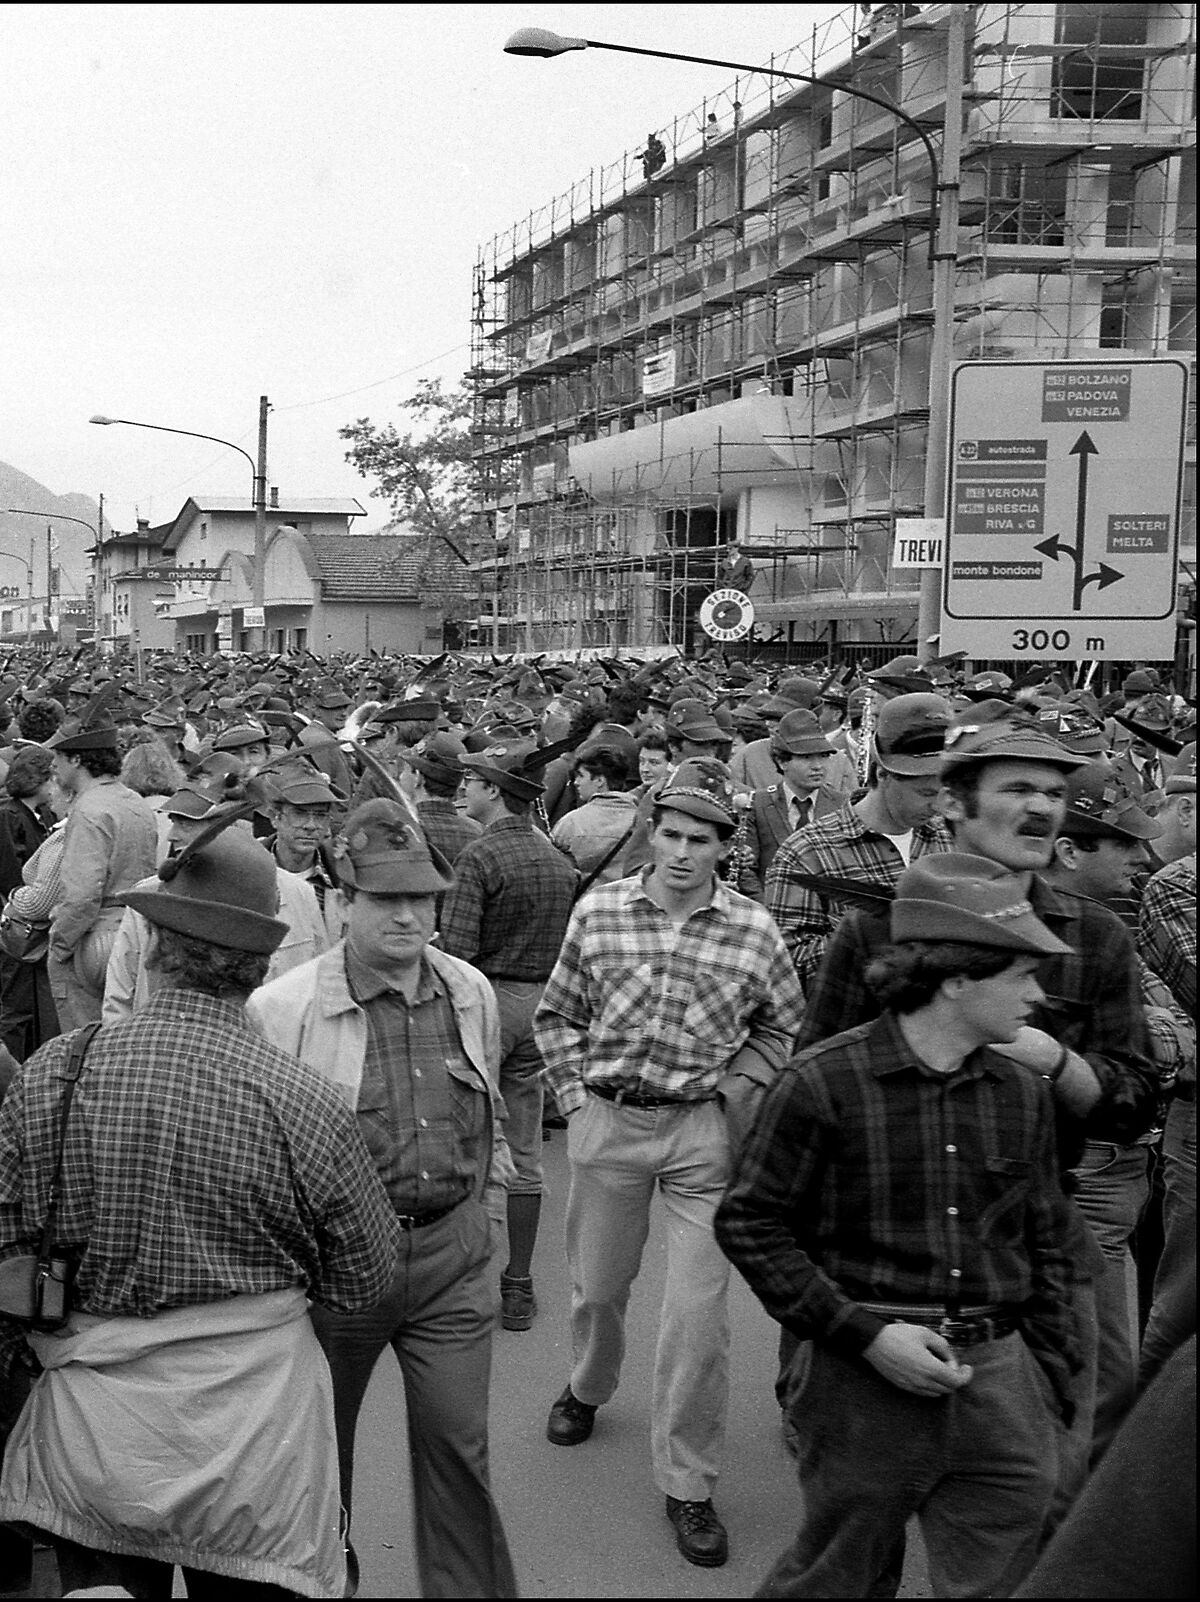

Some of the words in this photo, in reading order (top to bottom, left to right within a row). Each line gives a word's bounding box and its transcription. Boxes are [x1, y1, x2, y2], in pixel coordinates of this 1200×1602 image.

[1068, 375, 1129, 385] BOLZANO
[1067, 391, 1118, 401] PADOVA
[1067, 407, 1121, 417] VENEZIA
[988, 446, 1036, 454] autostrada
[987, 488, 1039, 498] VERONA
[986, 504, 1040, 514] BRESCIA
[986, 519, 1014, 529] RIVA
[1113, 520, 1167, 531] SOLTERI
[1112, 536, 1155, 547] MELTA
[899, 539, 942, 562] TREVI
[953, 565, 989, 575] monte
[992, 565, 1041, 575] bondone
[707, 591, 751, 609] SEZIONE
[705, 622, 747, 639] TREVISO
[1012, 629, 1070, 651] 300
[1086, 637, 1105, 651] m
